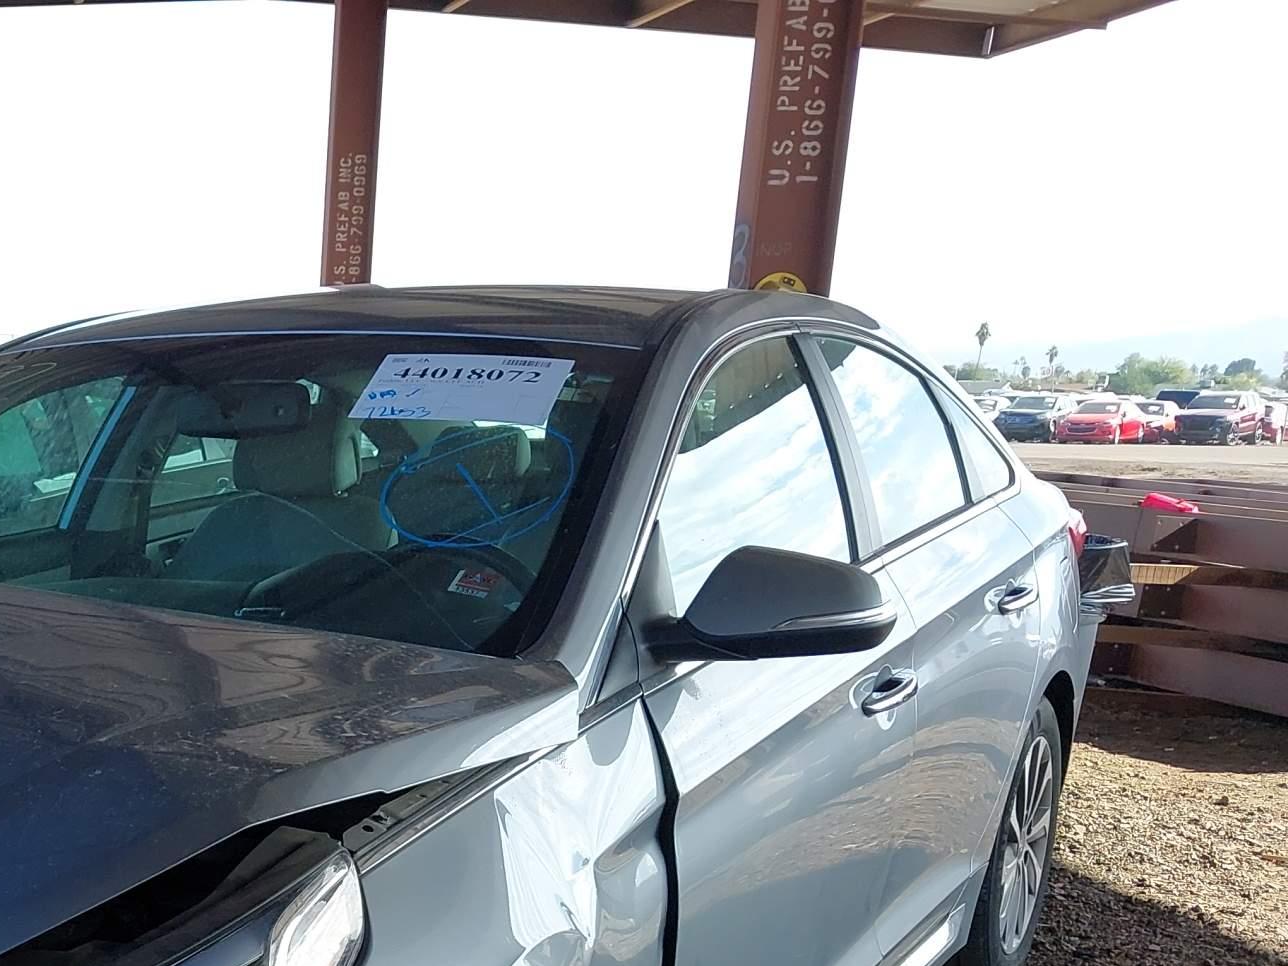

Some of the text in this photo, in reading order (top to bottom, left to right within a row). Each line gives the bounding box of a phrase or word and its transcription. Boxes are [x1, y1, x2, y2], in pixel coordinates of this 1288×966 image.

[768, 0, 810, 185] U.S. PREFAB
[796, 0, 838, 183] 1-866-799-
[338, 152, 353, 182] INC.
[335, 191, 350, 252] PREFAB
[348, 154, 368, 283] -866-799-0969
[393, 366, 543, 383] 44018072
